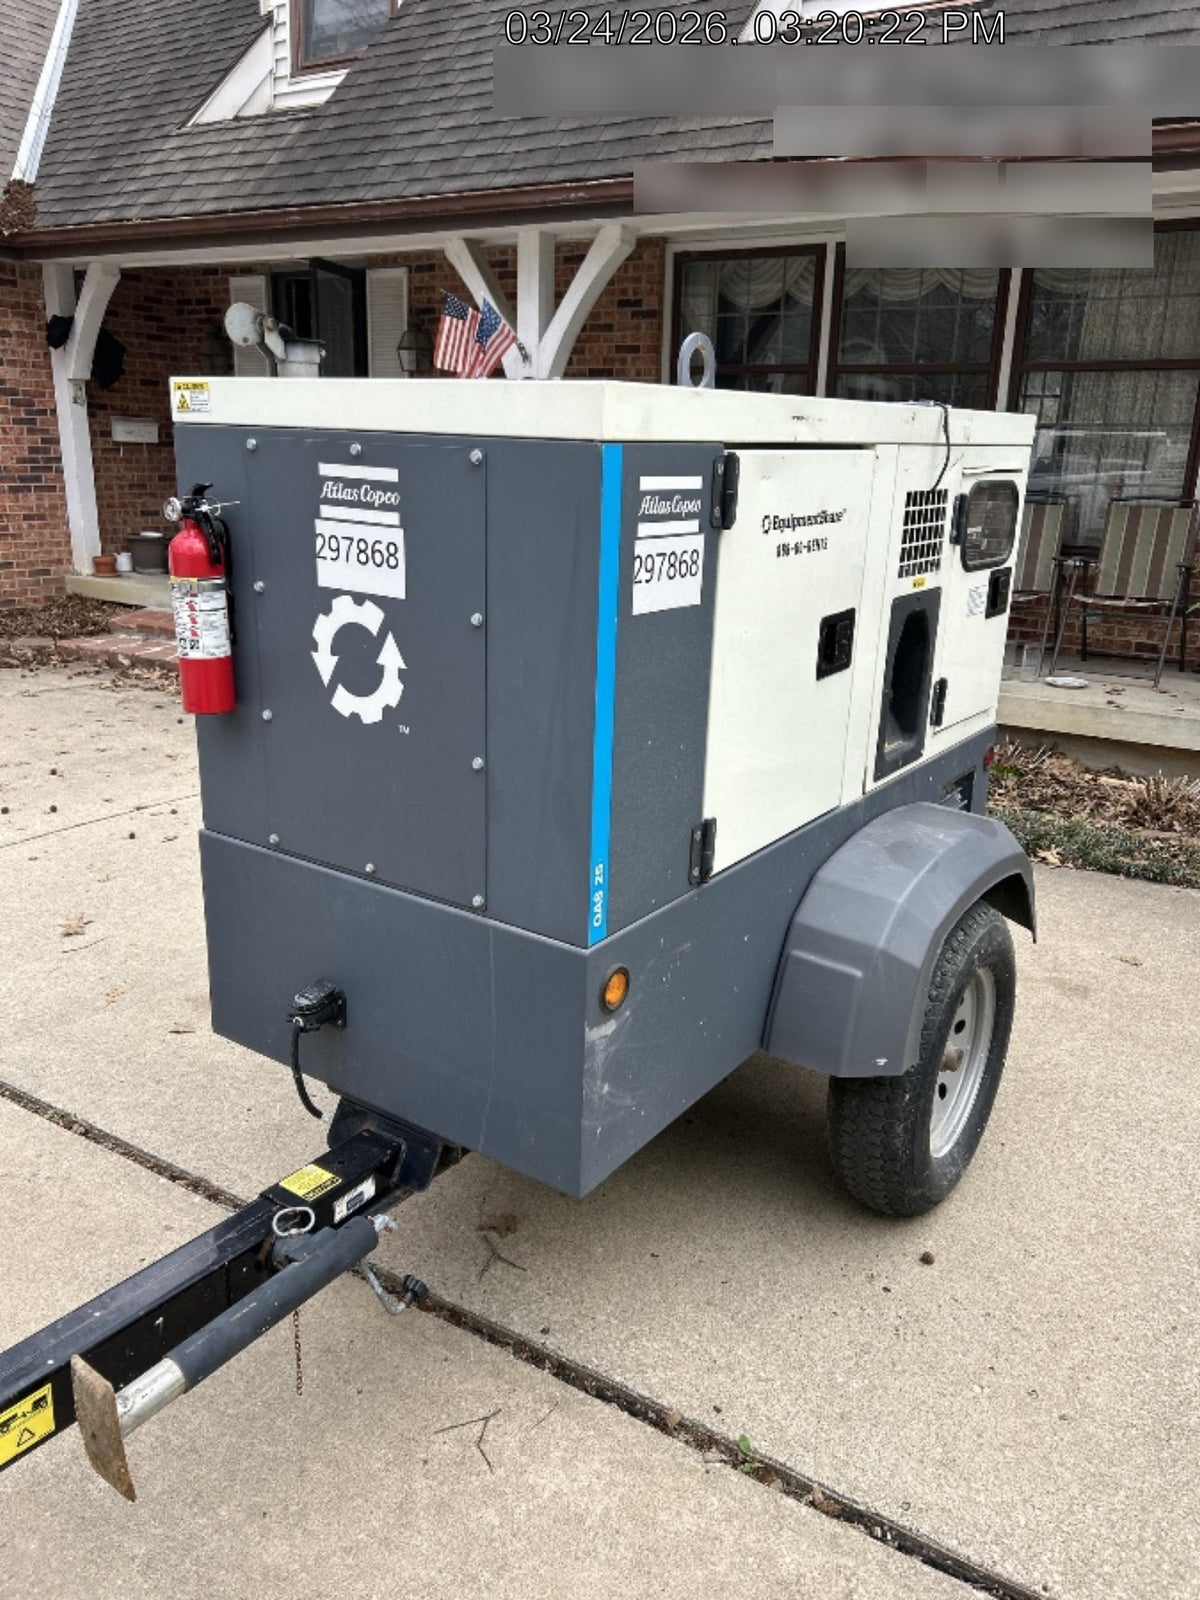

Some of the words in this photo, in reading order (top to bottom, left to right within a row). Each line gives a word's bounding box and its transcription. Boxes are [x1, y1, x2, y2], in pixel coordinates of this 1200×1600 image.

[319, 481, 359, 501] Atlas
[360, 484, 400, 507] Copco
[638, 495, 671, 516] Atlas
[671, 494, 701, 517] Copco
[315, 532, 399, 570] 297868
[634, 548, 700, 584] 297868
[594, 863, 604, 886] 25
[593, 890, 603, 927] QAS
